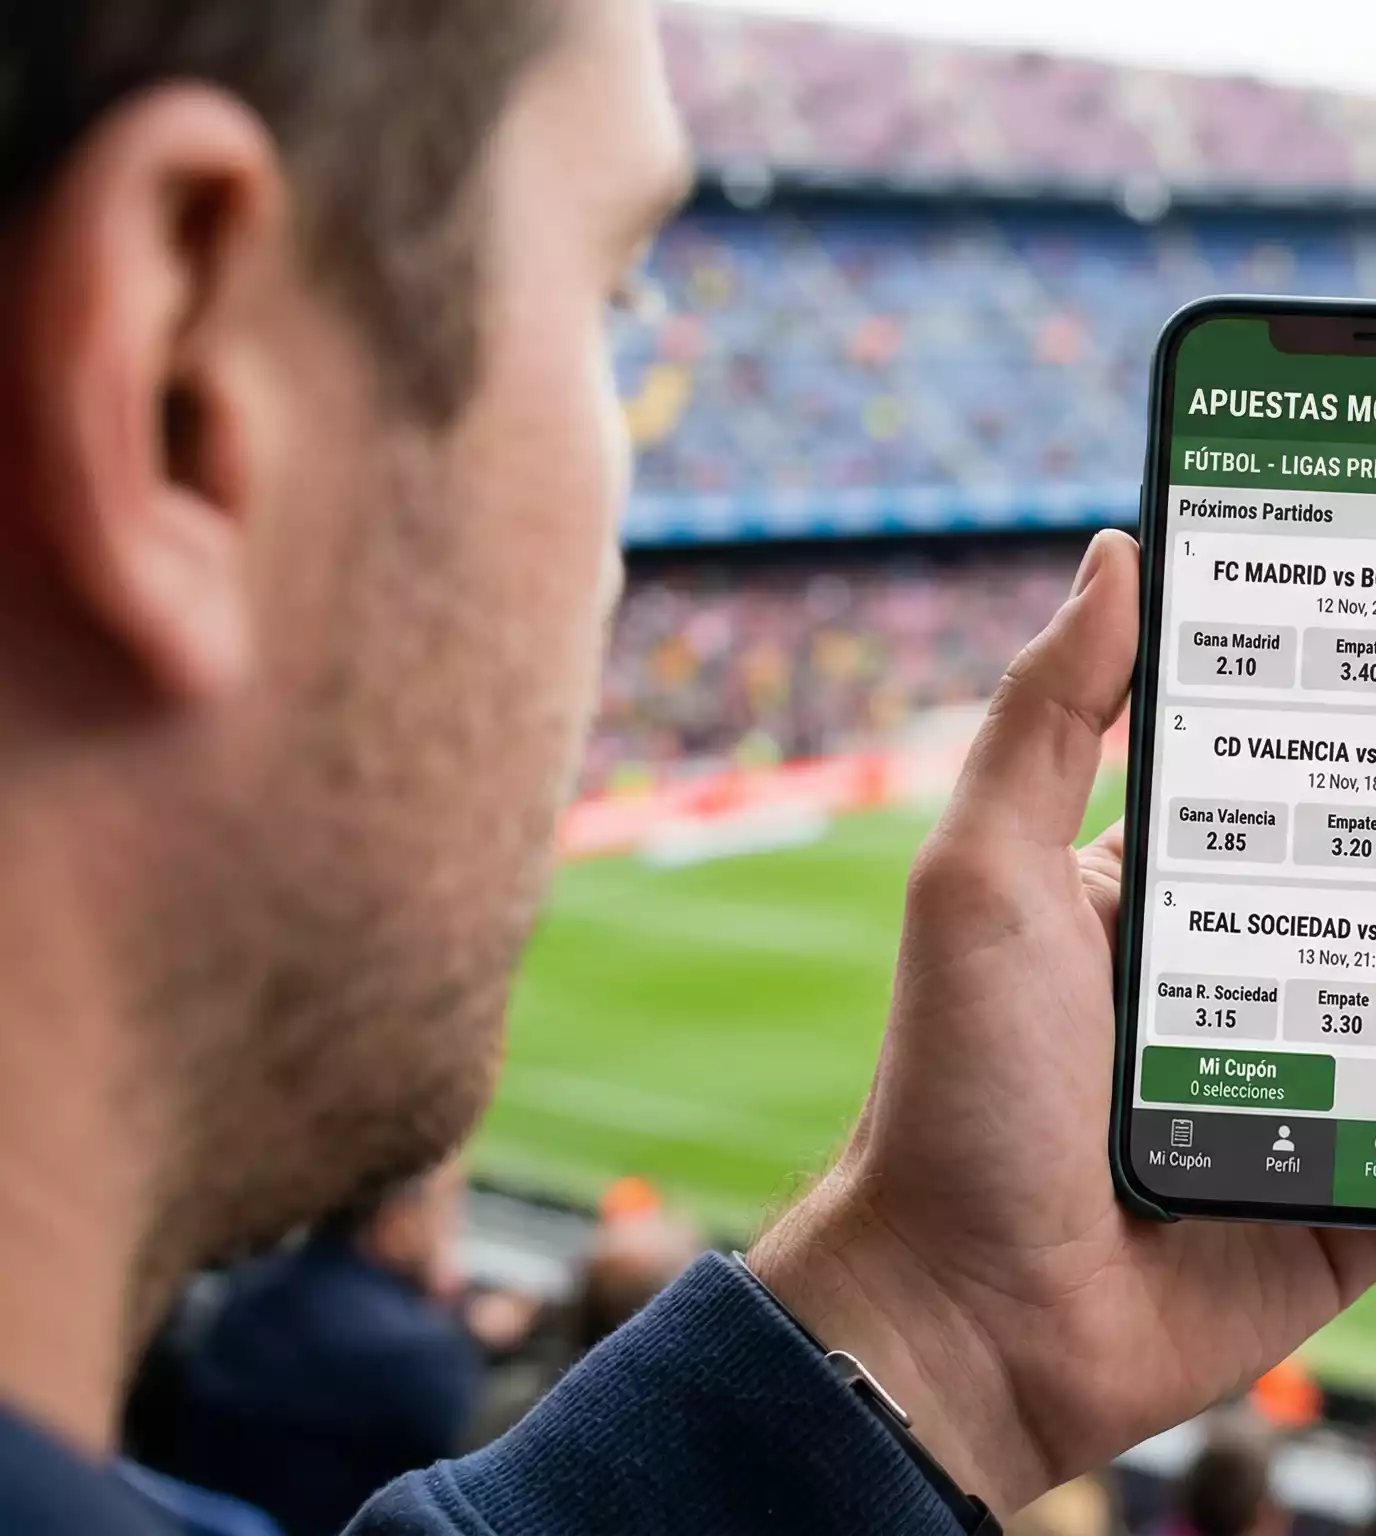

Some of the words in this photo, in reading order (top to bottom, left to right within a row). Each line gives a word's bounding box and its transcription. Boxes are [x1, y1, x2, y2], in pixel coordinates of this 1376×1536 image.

[1189, 388, 1338, 420] APUESTAS
[1185, 447, 1260, 472] FÚTBOL
[1282, 455, 1340, 476] LIGAS
[1180, 499, 1257, 519] Próximos
[1263, 503, 1333, 522] Partidos
[1184, 541, 1195, 556] 1.
[1214, 561, 1239, 581] FC
[1246, 562, 1326, 585] MADRID
[1333, 571, 1354, 587] vs
[1317, 598, 1333, 613] 12
[1339, 599, 1367, 617] Nov,
[1194, 632, 1227, 647] Gana
[1232, 634, 1279, 649] Madrid
[1217, 656, 1256, 676] 2.10
[1174, 715, 1186, 730] 2.
[1214, 736, 1241, 756] CD
[1248, 738, 1349, 762] VALENCIA
[1356, 748, 1376, 763] vs
[1309, 773, 1325, 788] 12
[1330, 774, 1359, 792] Nov,
[1180, 807, 1213, 822] Gana
[1218, 809, 1275, 825] Valencia
[1207, 832, 1246, 851] 2.85
[1332, 838, 1371, 857] 3.20
[1164, 891, 1176, 906] 3.
[1190, 911, 1241, 933] REAL
[1248, 914, 1350, 938] SOCIEDAD
[1299, 949, 1314, 964] 13
[1320, 950, 1349, 968] Nov,
[1158, 983, 1192, 998] Gana
[1197, 985, 1209, 999] R.
[1215, 986, 1277, 1002] Sociedad
[1319, 990, 1369, 1009] Empate
[1196, 1008, 1236, 1028] 3.15
[1322, 1014, 1362, 1034] 3.30
[1200, 1058, 1220, 1075] Mi
[1225, 1059, 1276, 1081] Cupón
[1191, 1081, 1199, 1095] 0
[1203, 1082, 1284, 1099] selecciones
[1150, 1151, 1165, 1165] Mi
[1170, 1152, 1211, 1170] Cupón
[1267, 1157, 1300, 1172] Perfil
